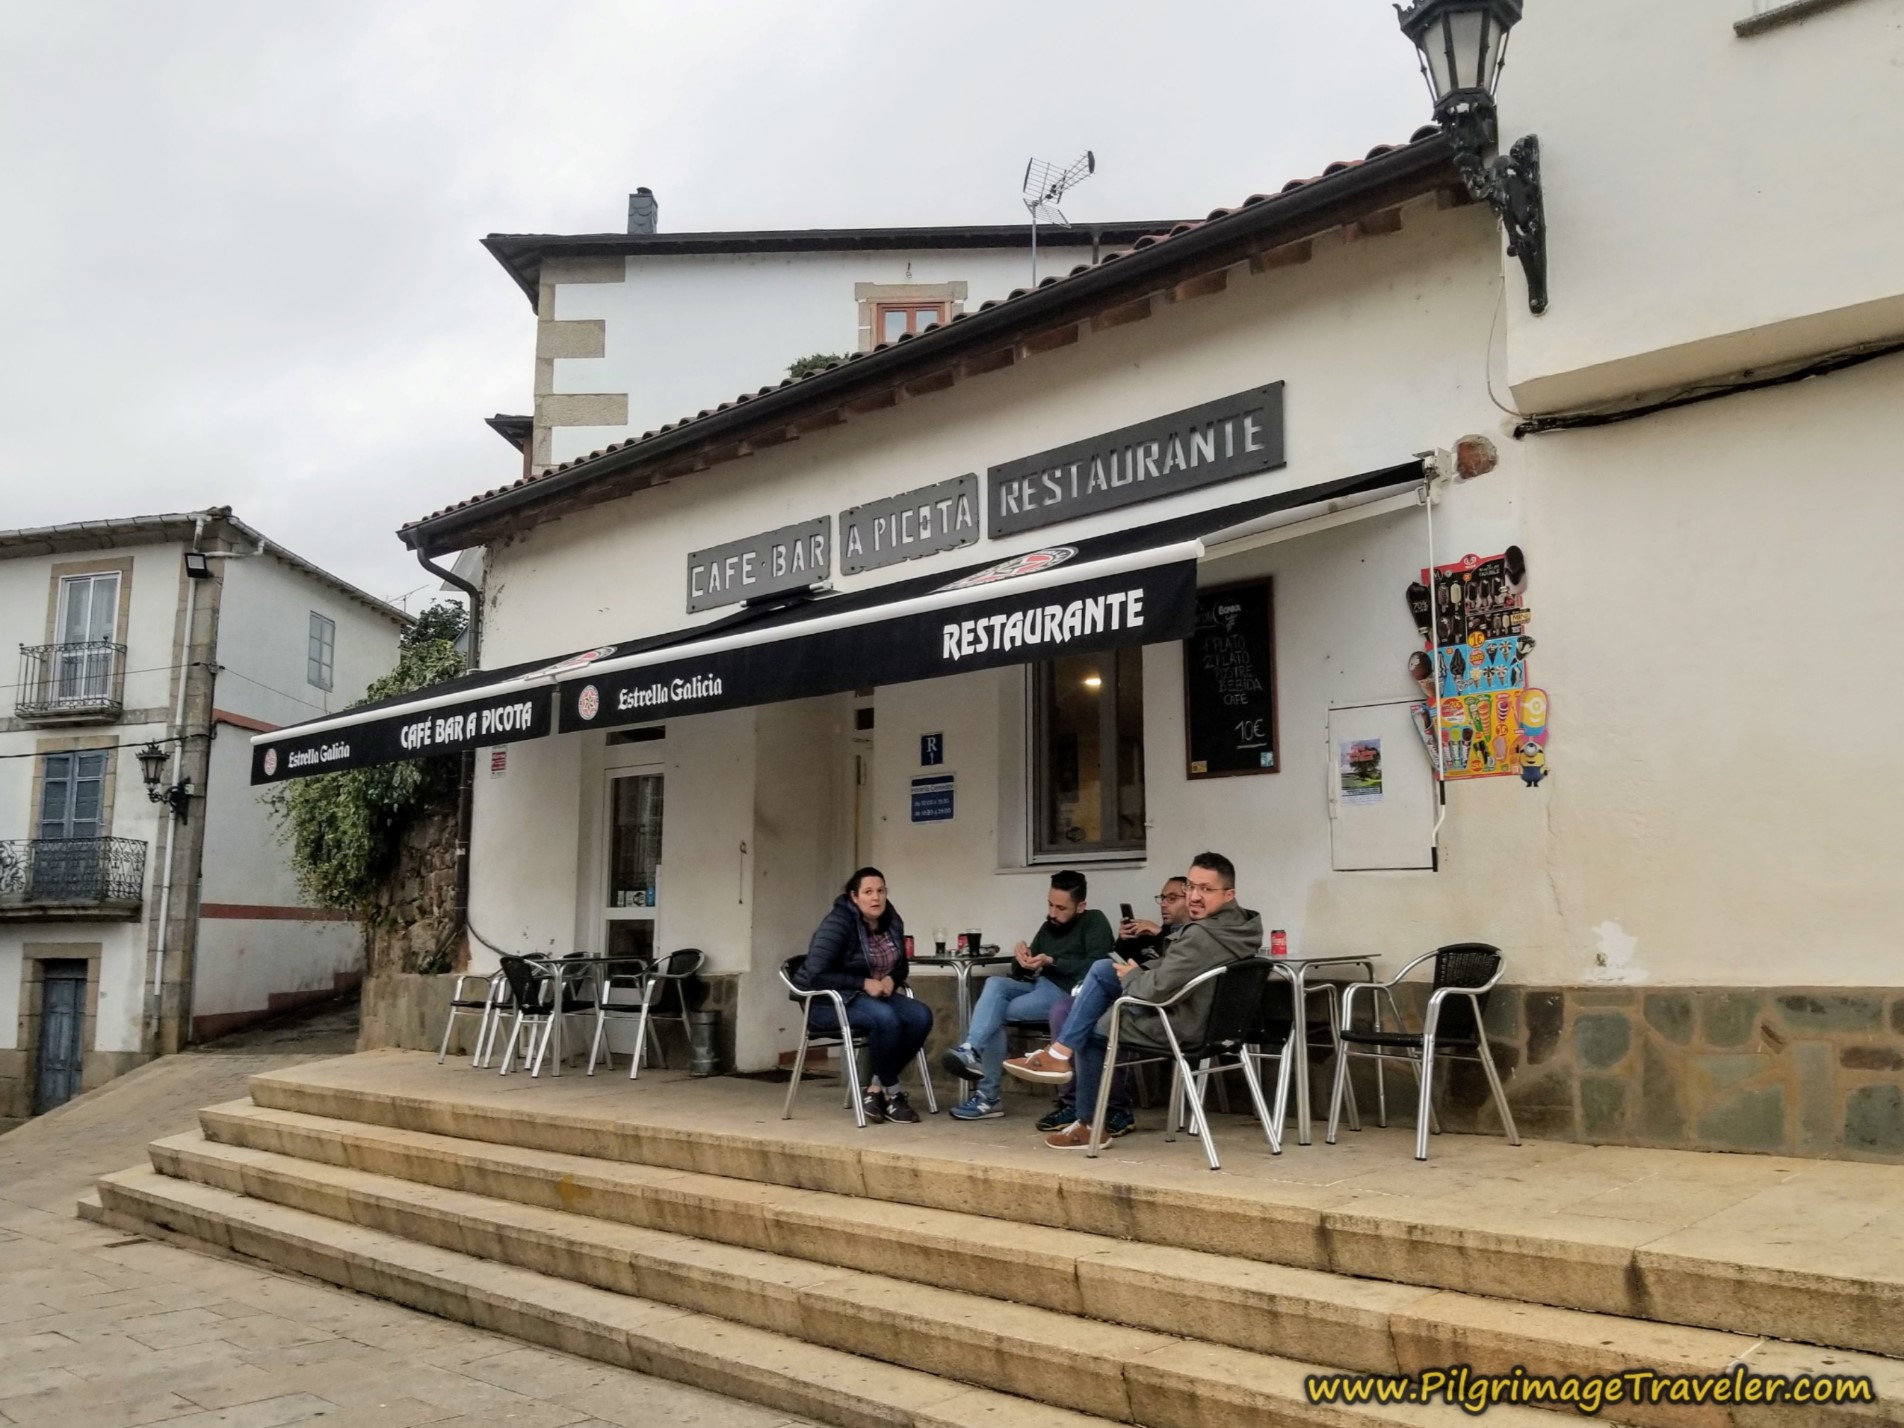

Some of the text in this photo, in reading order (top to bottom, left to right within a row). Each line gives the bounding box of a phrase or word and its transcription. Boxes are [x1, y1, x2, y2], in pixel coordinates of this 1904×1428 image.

[999, 407, 1266, 518] RESTAURANTE
[847, 494, 972, 558] A PICOTA
[691, 534, 825, 598] CAFE BAR
[943, 588, 1145, 661] RESTAURANTE
[617, 673, 722, 710] Estrella Galicia
[400, 701, 533, 750] CAFÉ BAR A PICOTA
[926, 737, 937, 752] R
[1234, 718, 1265, 741] 10€
[288, 741, 351, 768] Estrella Galicia
